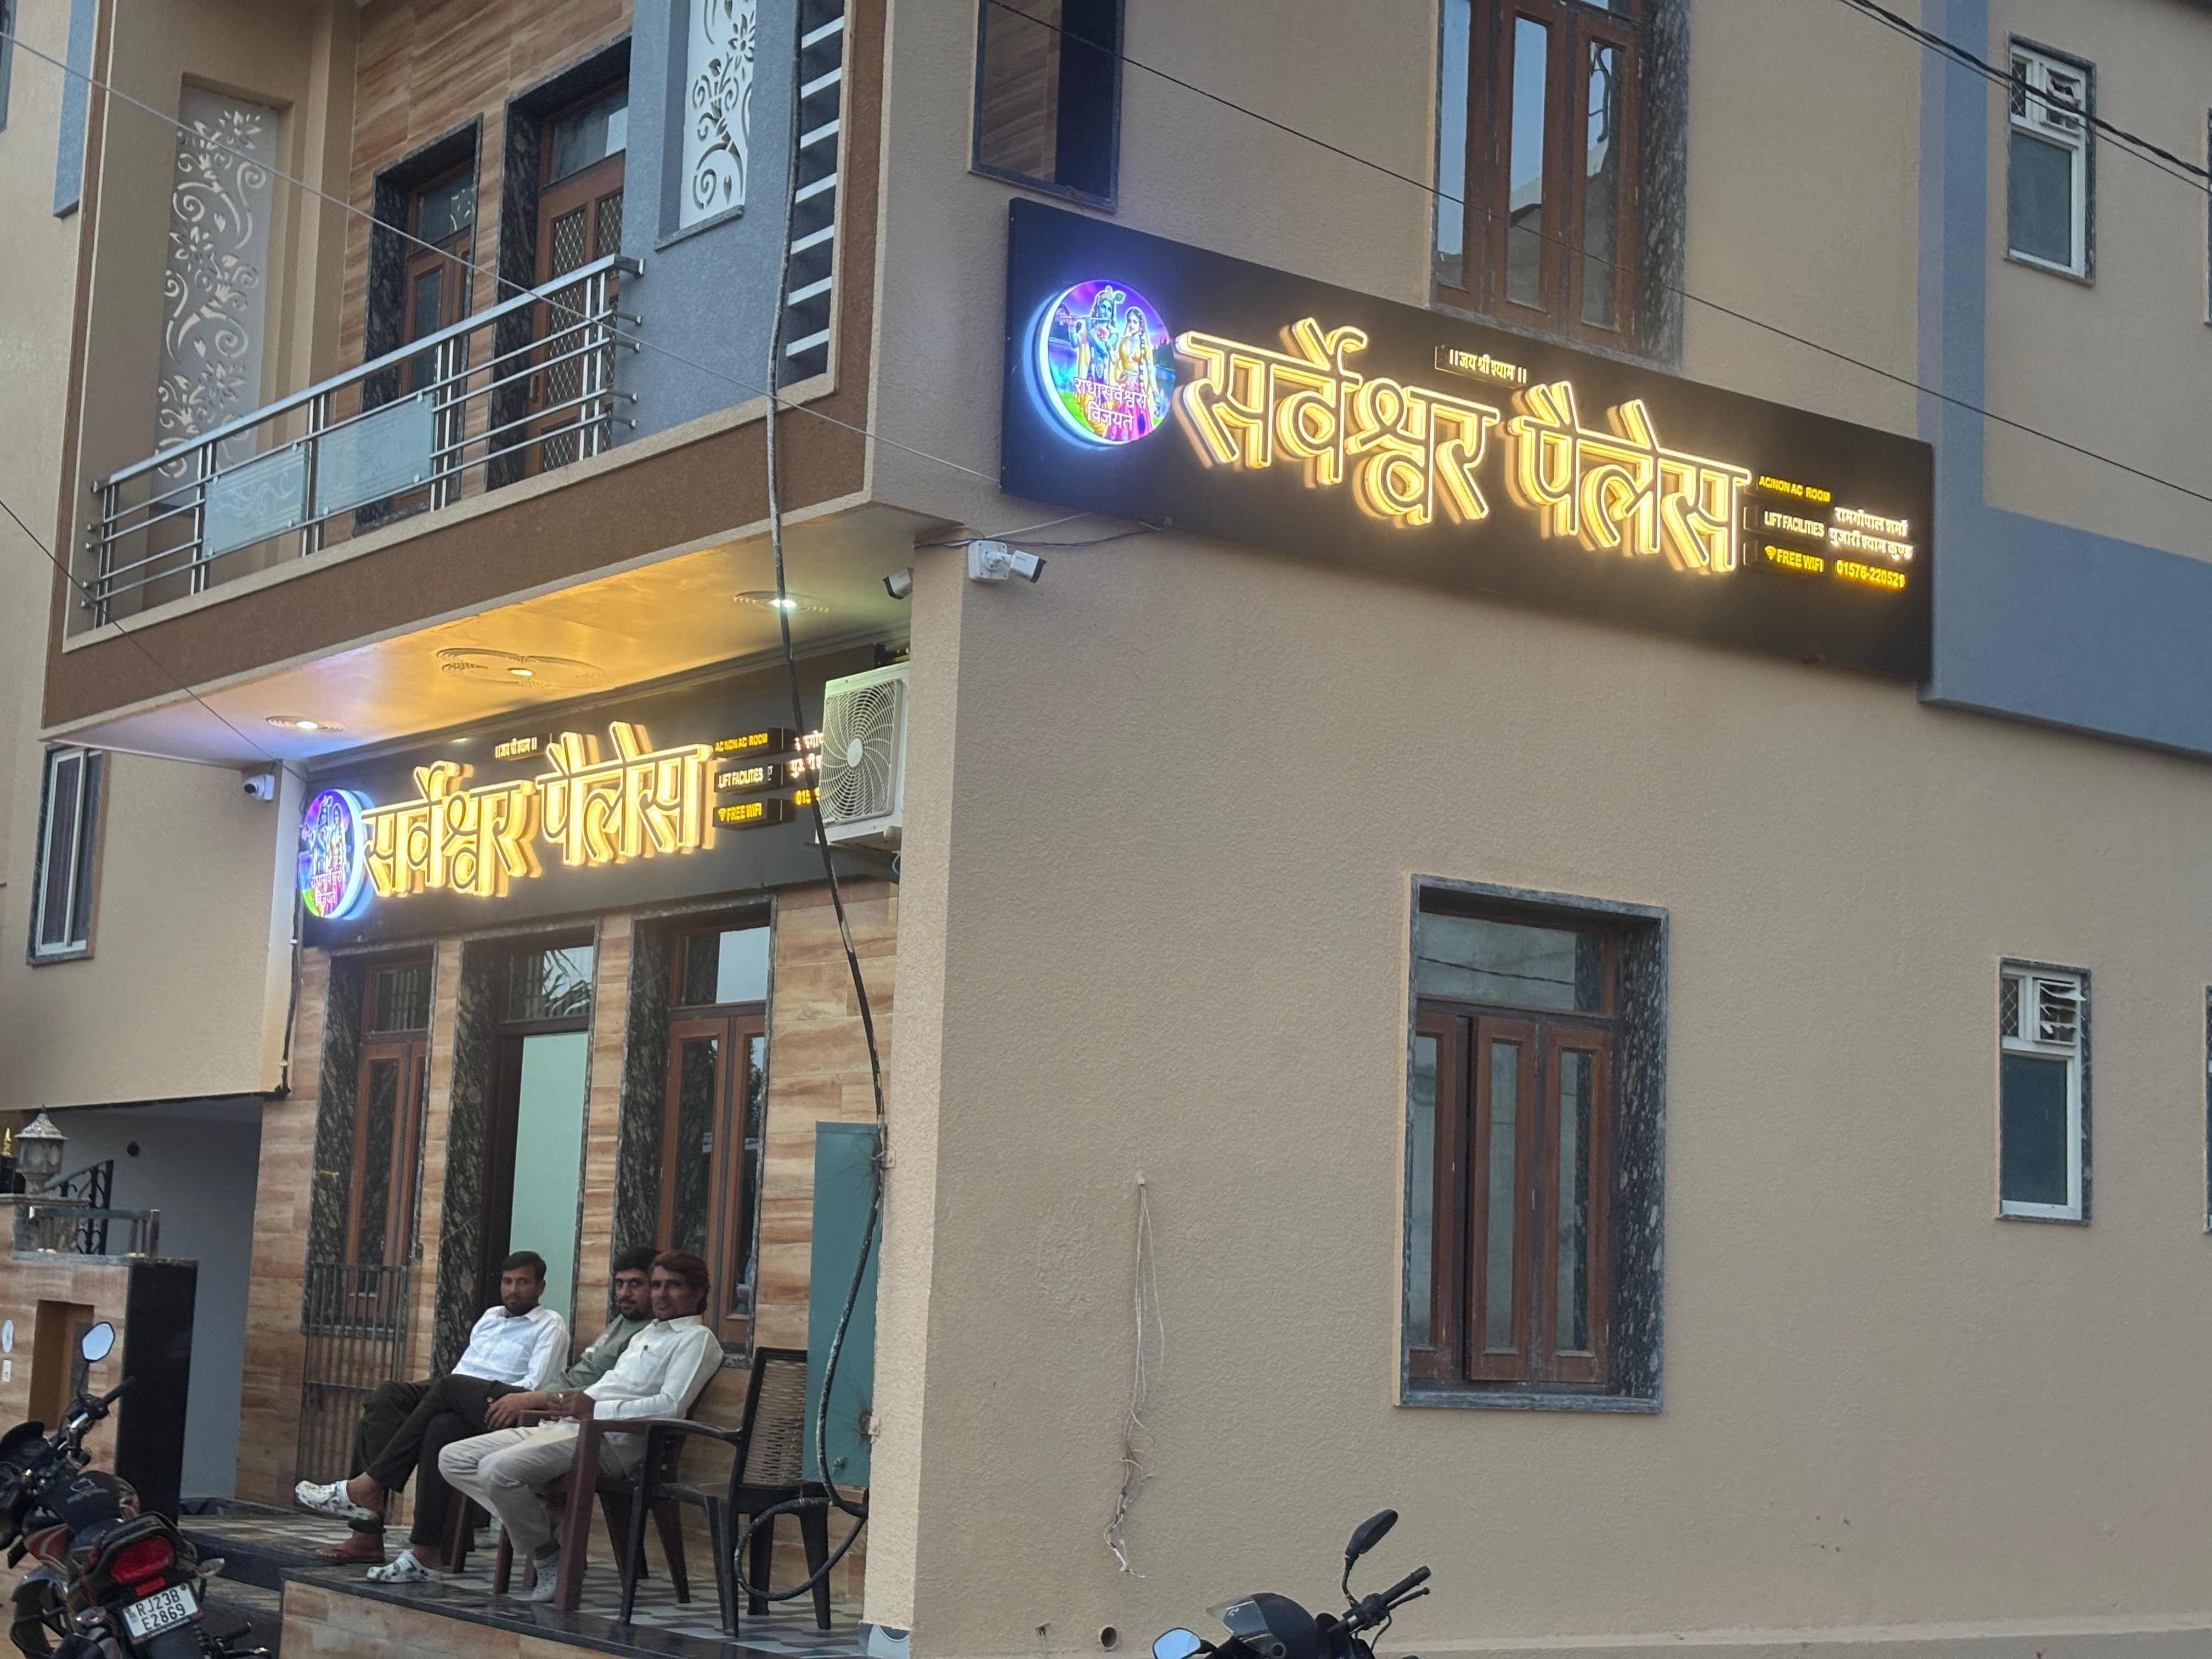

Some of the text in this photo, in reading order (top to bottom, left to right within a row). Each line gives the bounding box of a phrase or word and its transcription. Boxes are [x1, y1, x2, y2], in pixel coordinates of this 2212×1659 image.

[1477, 354, 1491, 374] श्री
[1491, 360, 1516, 381] श्याम
[1087, 400, 1135, 431] विजयते
[1174, 316, 1751, 574] सर्वेश्वर पैलेस
[1791, 483, 1803, 496] AC
[1805, 487, 1831, 503] ROOM
[1764, 511, 1825, 538] LIFT FACILITIES
[1828, 527, 1860, 546] पुजारी
[1885, 519, 1909, 537] शर्मा
[1776, 549, 1824, 573] FREE WIFI
[1835, 559, 1905, 588] 01576-220521
[748, 732, 768, 747] ROOM
[719, 767, 763, 788] LIFT FACILITIES
[360, 721, 714, 898] सर्वेश्वर पैलेस
[726, 803, 762, 822] FREE WIFI
[136, 1589, 180, 1617] RJ23B
[142, 1603, 186, 1631] E2869
